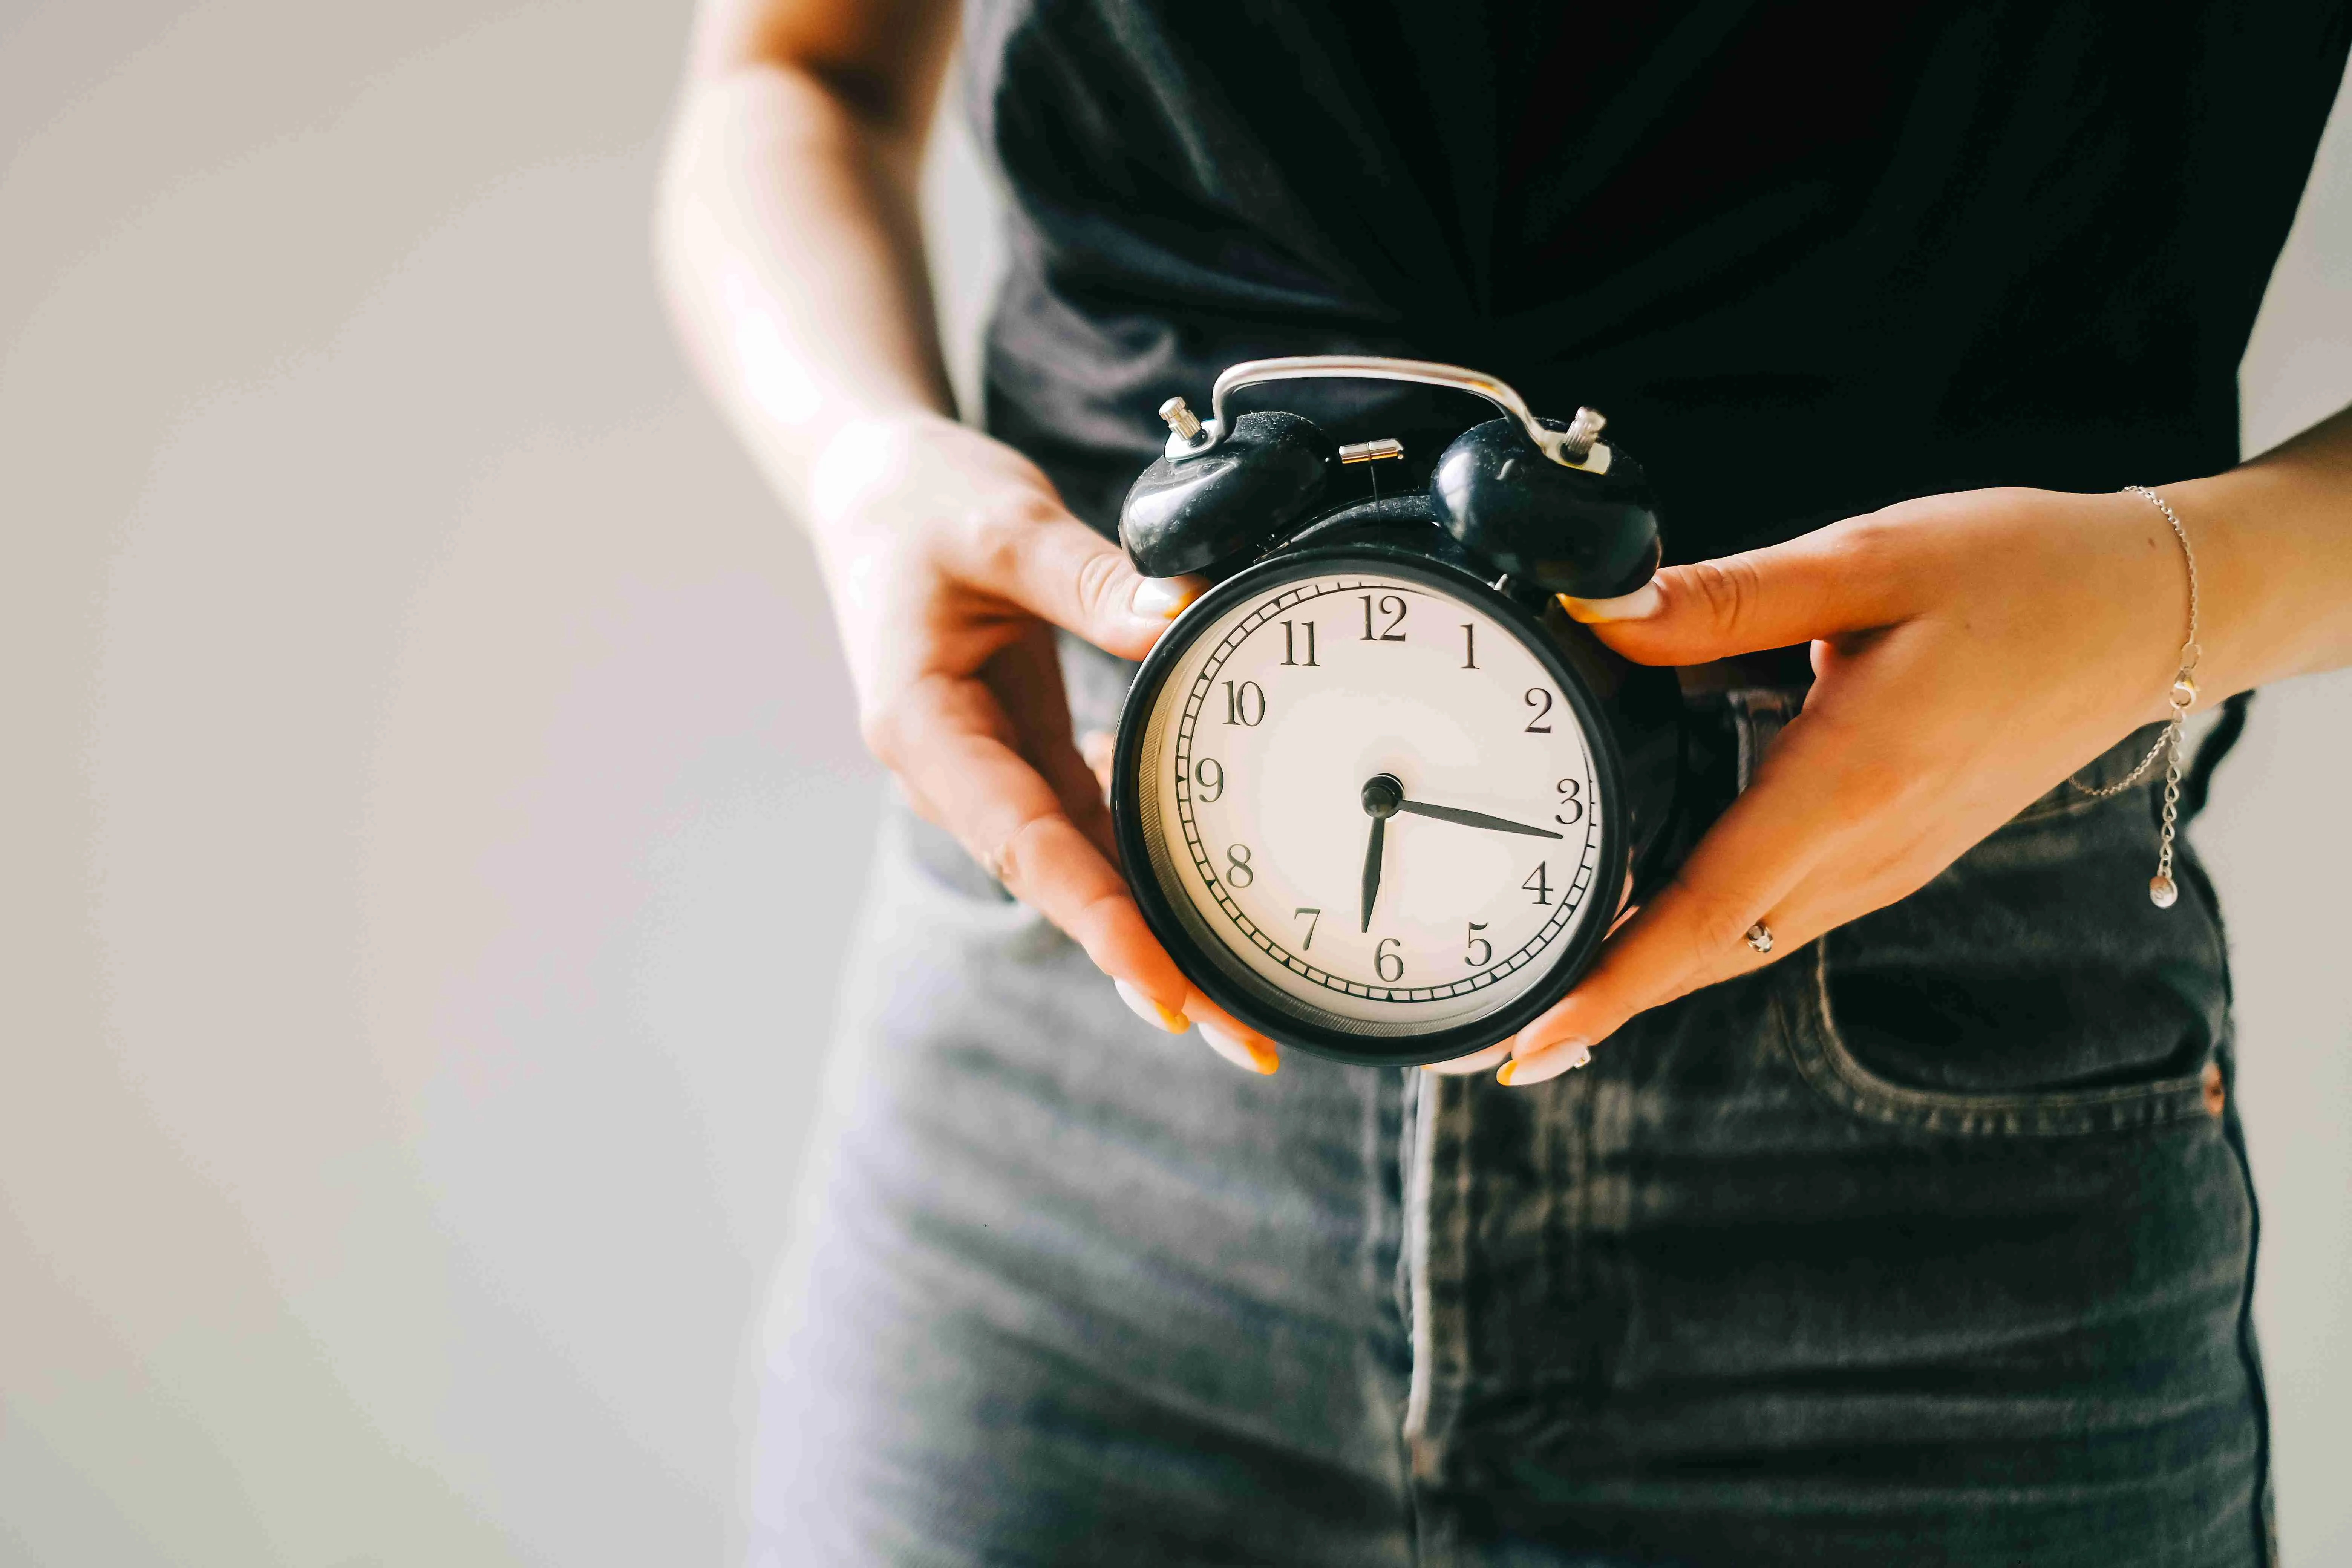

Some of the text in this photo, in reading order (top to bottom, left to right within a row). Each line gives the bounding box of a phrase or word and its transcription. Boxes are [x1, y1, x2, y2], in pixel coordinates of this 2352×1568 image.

[1358, 594, 1407, 642] 12
[1279, 620, 1321, 667] 11
[1460, 623, 1480, 670] 1
[1221, 680, 1266, 727] 10
[1525, 687, 1553, 734] 2
[1196, 758, 1224, 803] 9
[1555, 778, 1583, 825] 3
[1227, 844, 1254, 888] 8
[1522, 860, 1554, 906] 4
[1294, 908, 1321, 951] 7
[1465, 922, 1492, 967] 5
[1375, 938, 1404, 983] 6
